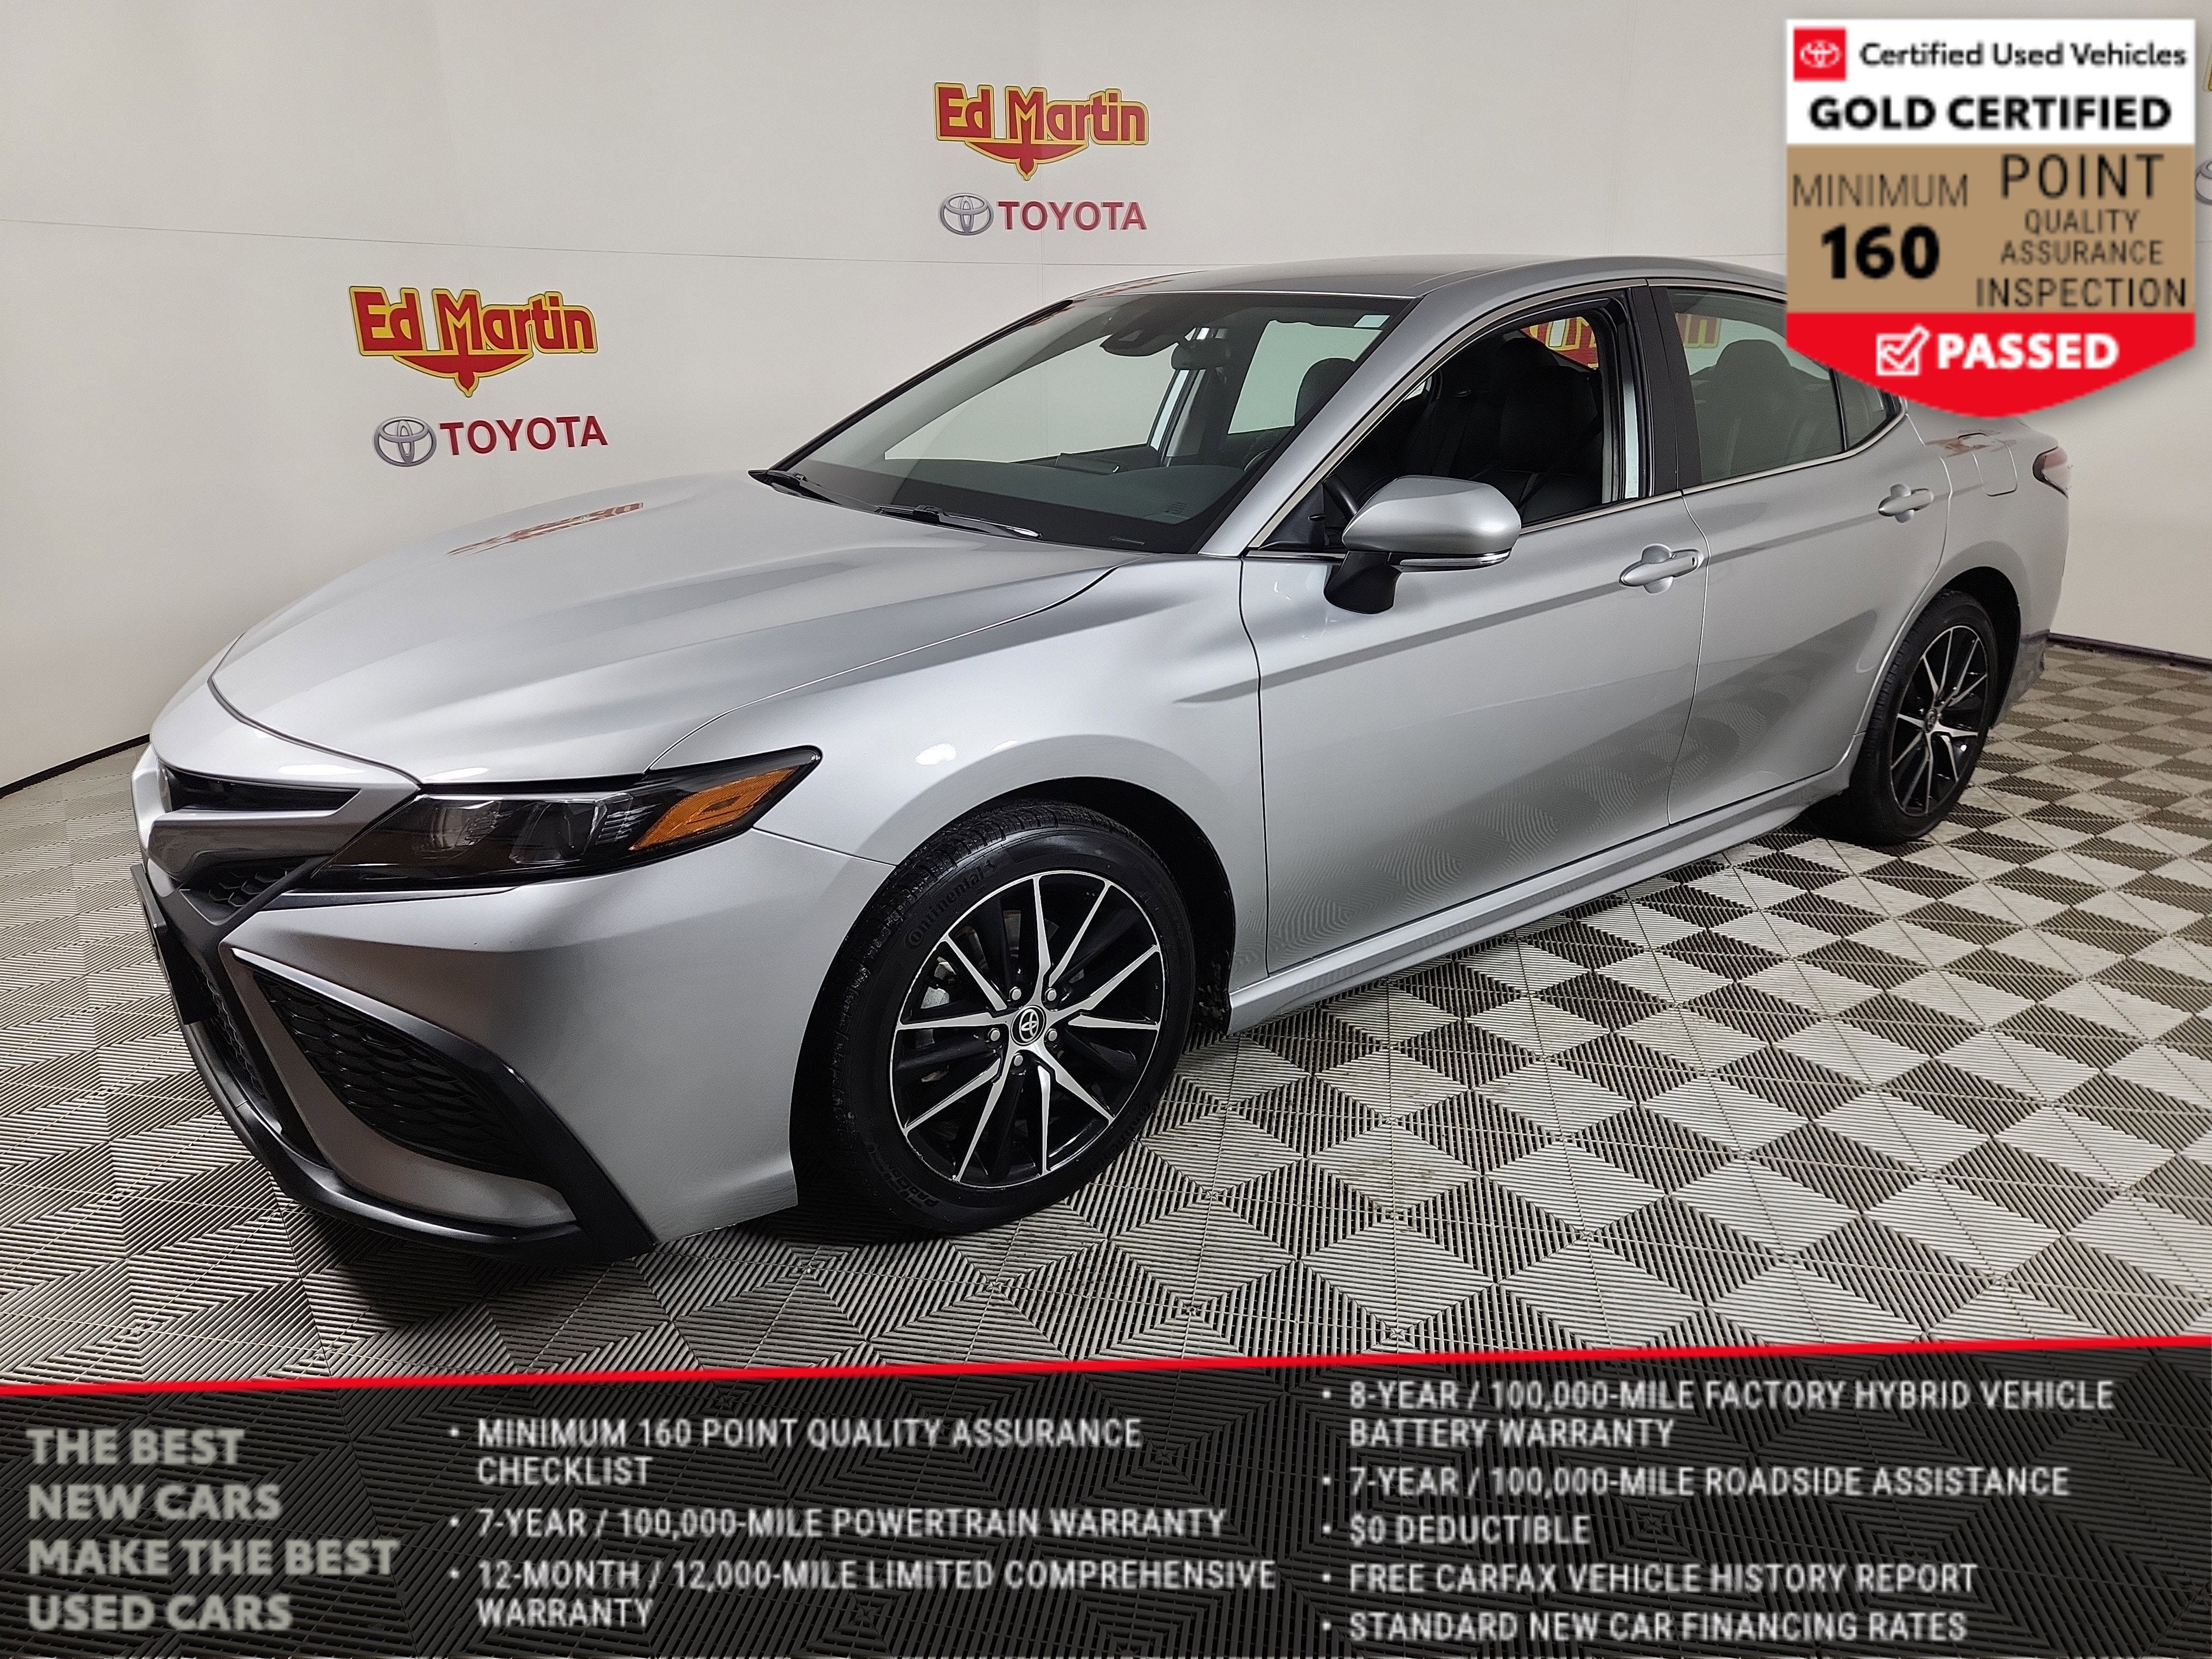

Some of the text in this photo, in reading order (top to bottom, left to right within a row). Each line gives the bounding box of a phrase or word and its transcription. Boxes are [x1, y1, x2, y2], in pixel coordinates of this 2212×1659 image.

[935, 82, 1148, 145] Ed Martin
[998, 201, 1148, 230] TOYOTA
[350, 286, 599, 357] Ed Martin
[440, 415, 608, 456] TOYOTA
[904, 865, 985, 950] Continental
